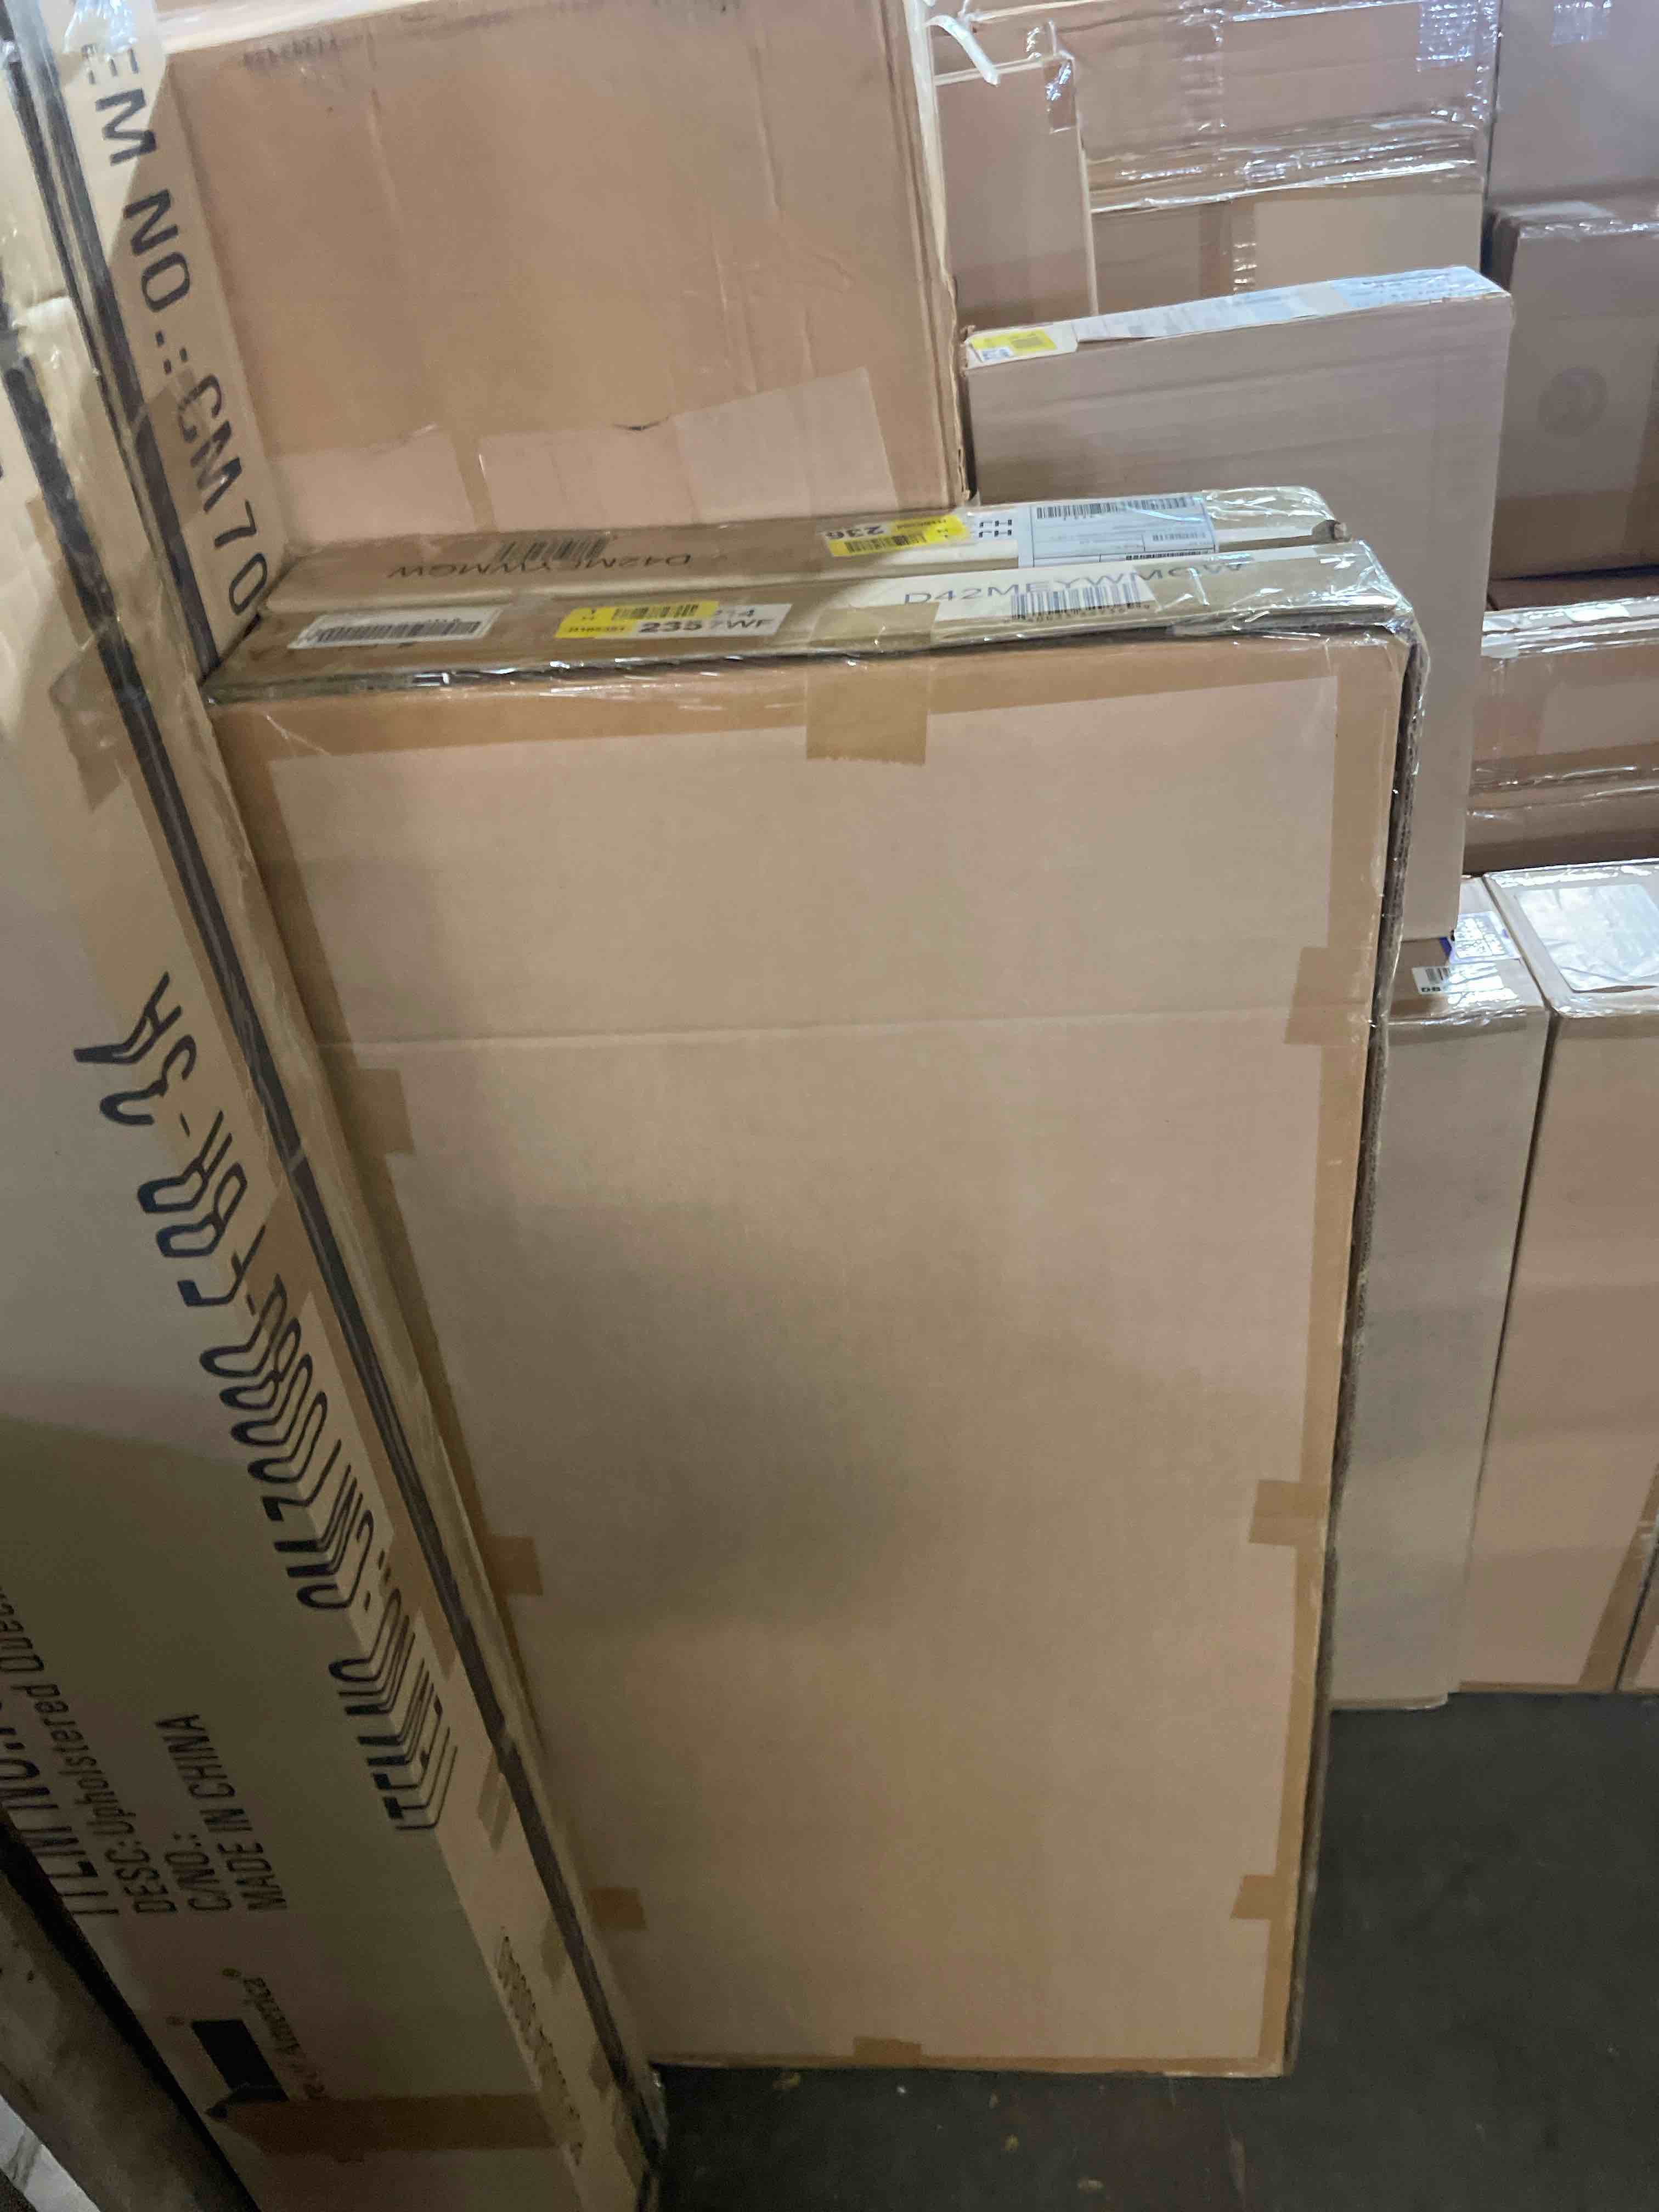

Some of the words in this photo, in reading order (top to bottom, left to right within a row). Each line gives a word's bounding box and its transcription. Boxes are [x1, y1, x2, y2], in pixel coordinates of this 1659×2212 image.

[155, 1714, 236, 1799] CHINA
[199, 1808, 253, 1832] IN
[217, 1842, 287, 1910] MADE
